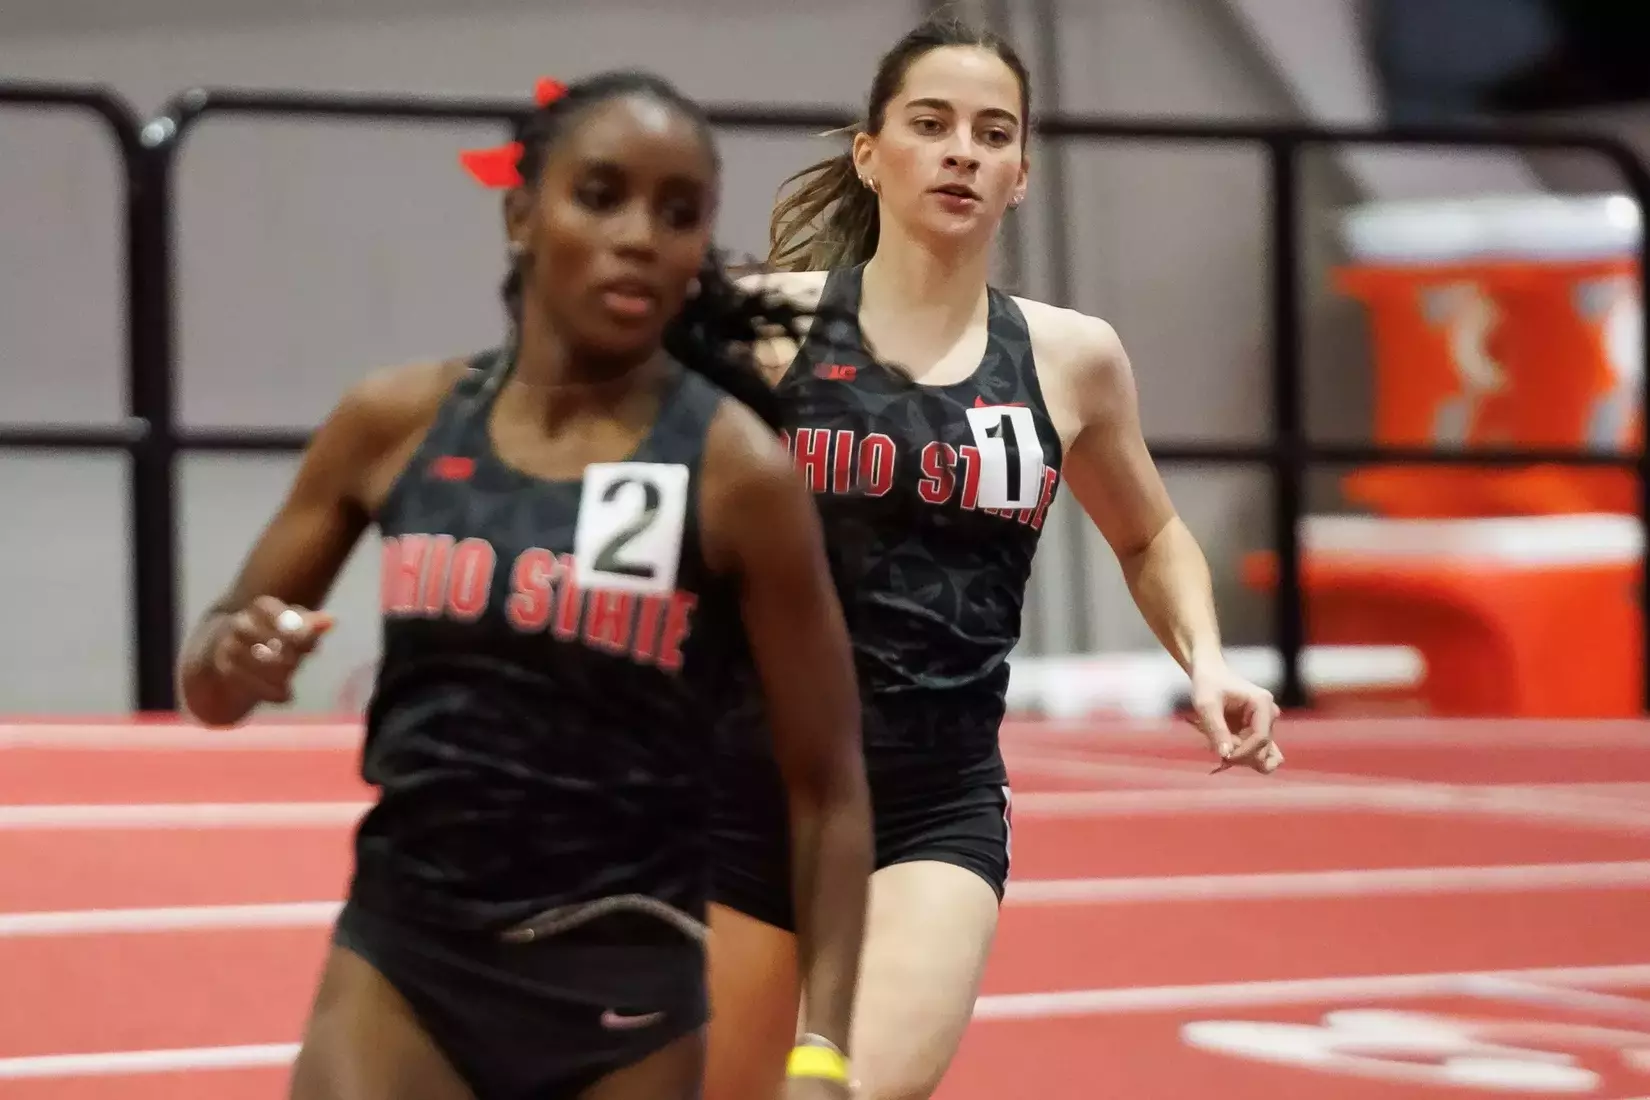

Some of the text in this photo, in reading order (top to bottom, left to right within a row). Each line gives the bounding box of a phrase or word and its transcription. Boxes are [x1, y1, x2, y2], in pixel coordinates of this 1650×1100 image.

[779, 427, 1057, 531] HIO STE
[984, 414, 1021, 502] 1
[592, 478, 662, 580] 2
